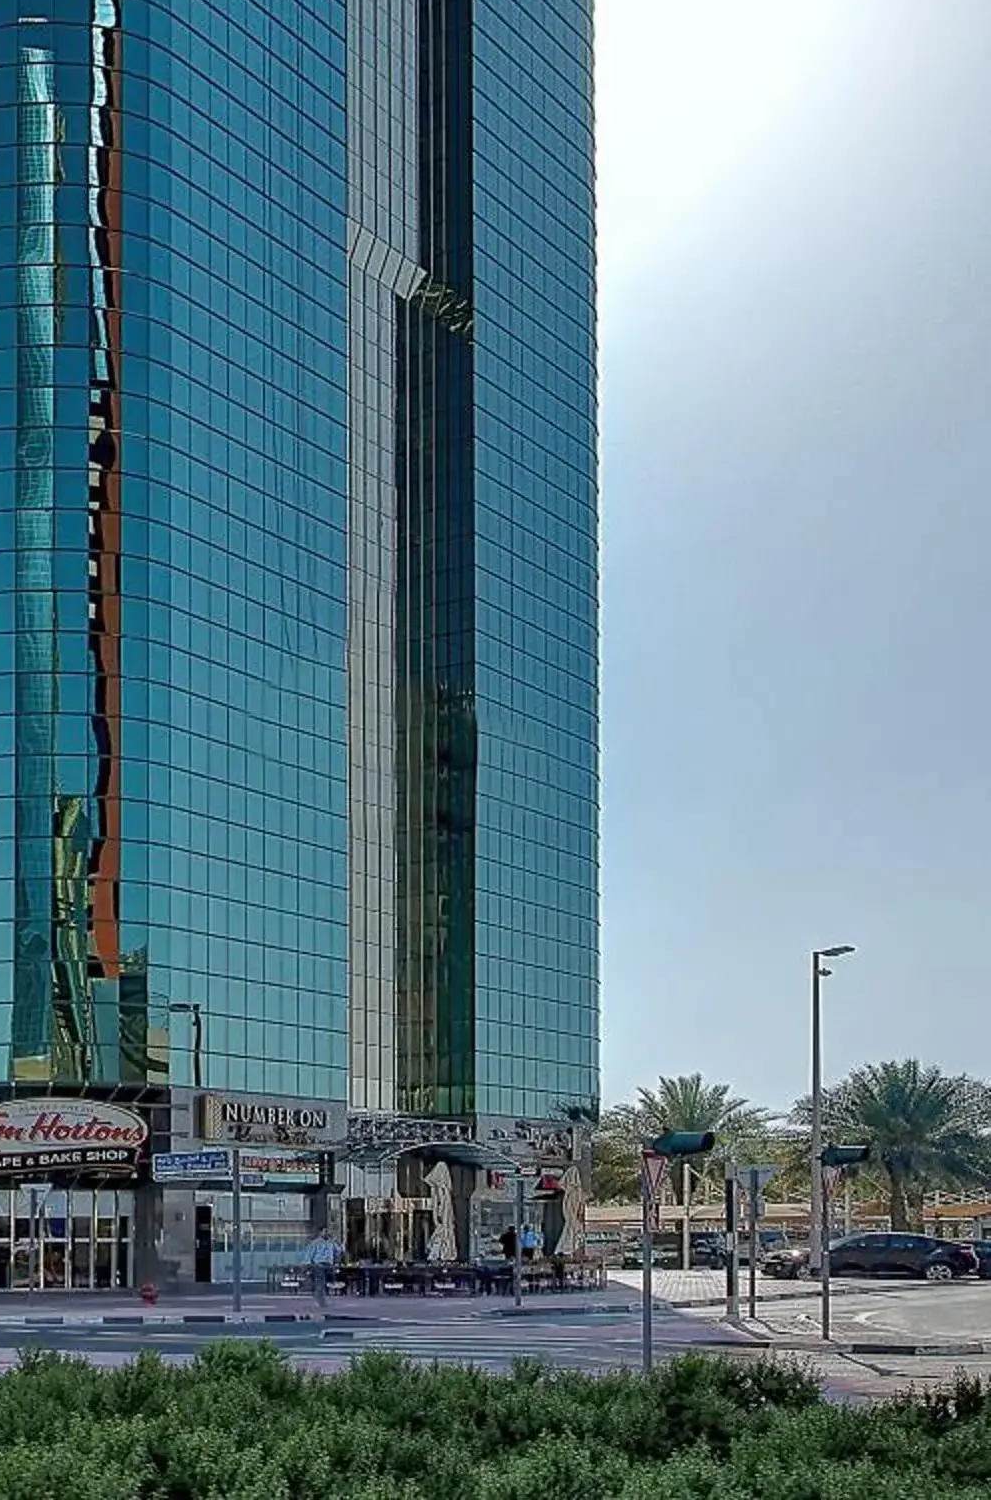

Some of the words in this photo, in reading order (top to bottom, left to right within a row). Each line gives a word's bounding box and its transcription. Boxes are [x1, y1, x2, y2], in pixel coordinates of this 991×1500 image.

[225, 1103, 295, 1126] NUMBER
[29, 1113, 145, 1141] Hortons
[39, 1152, 82, 1165] BAKE
[86, 1149, 128, 1161] SHOP
